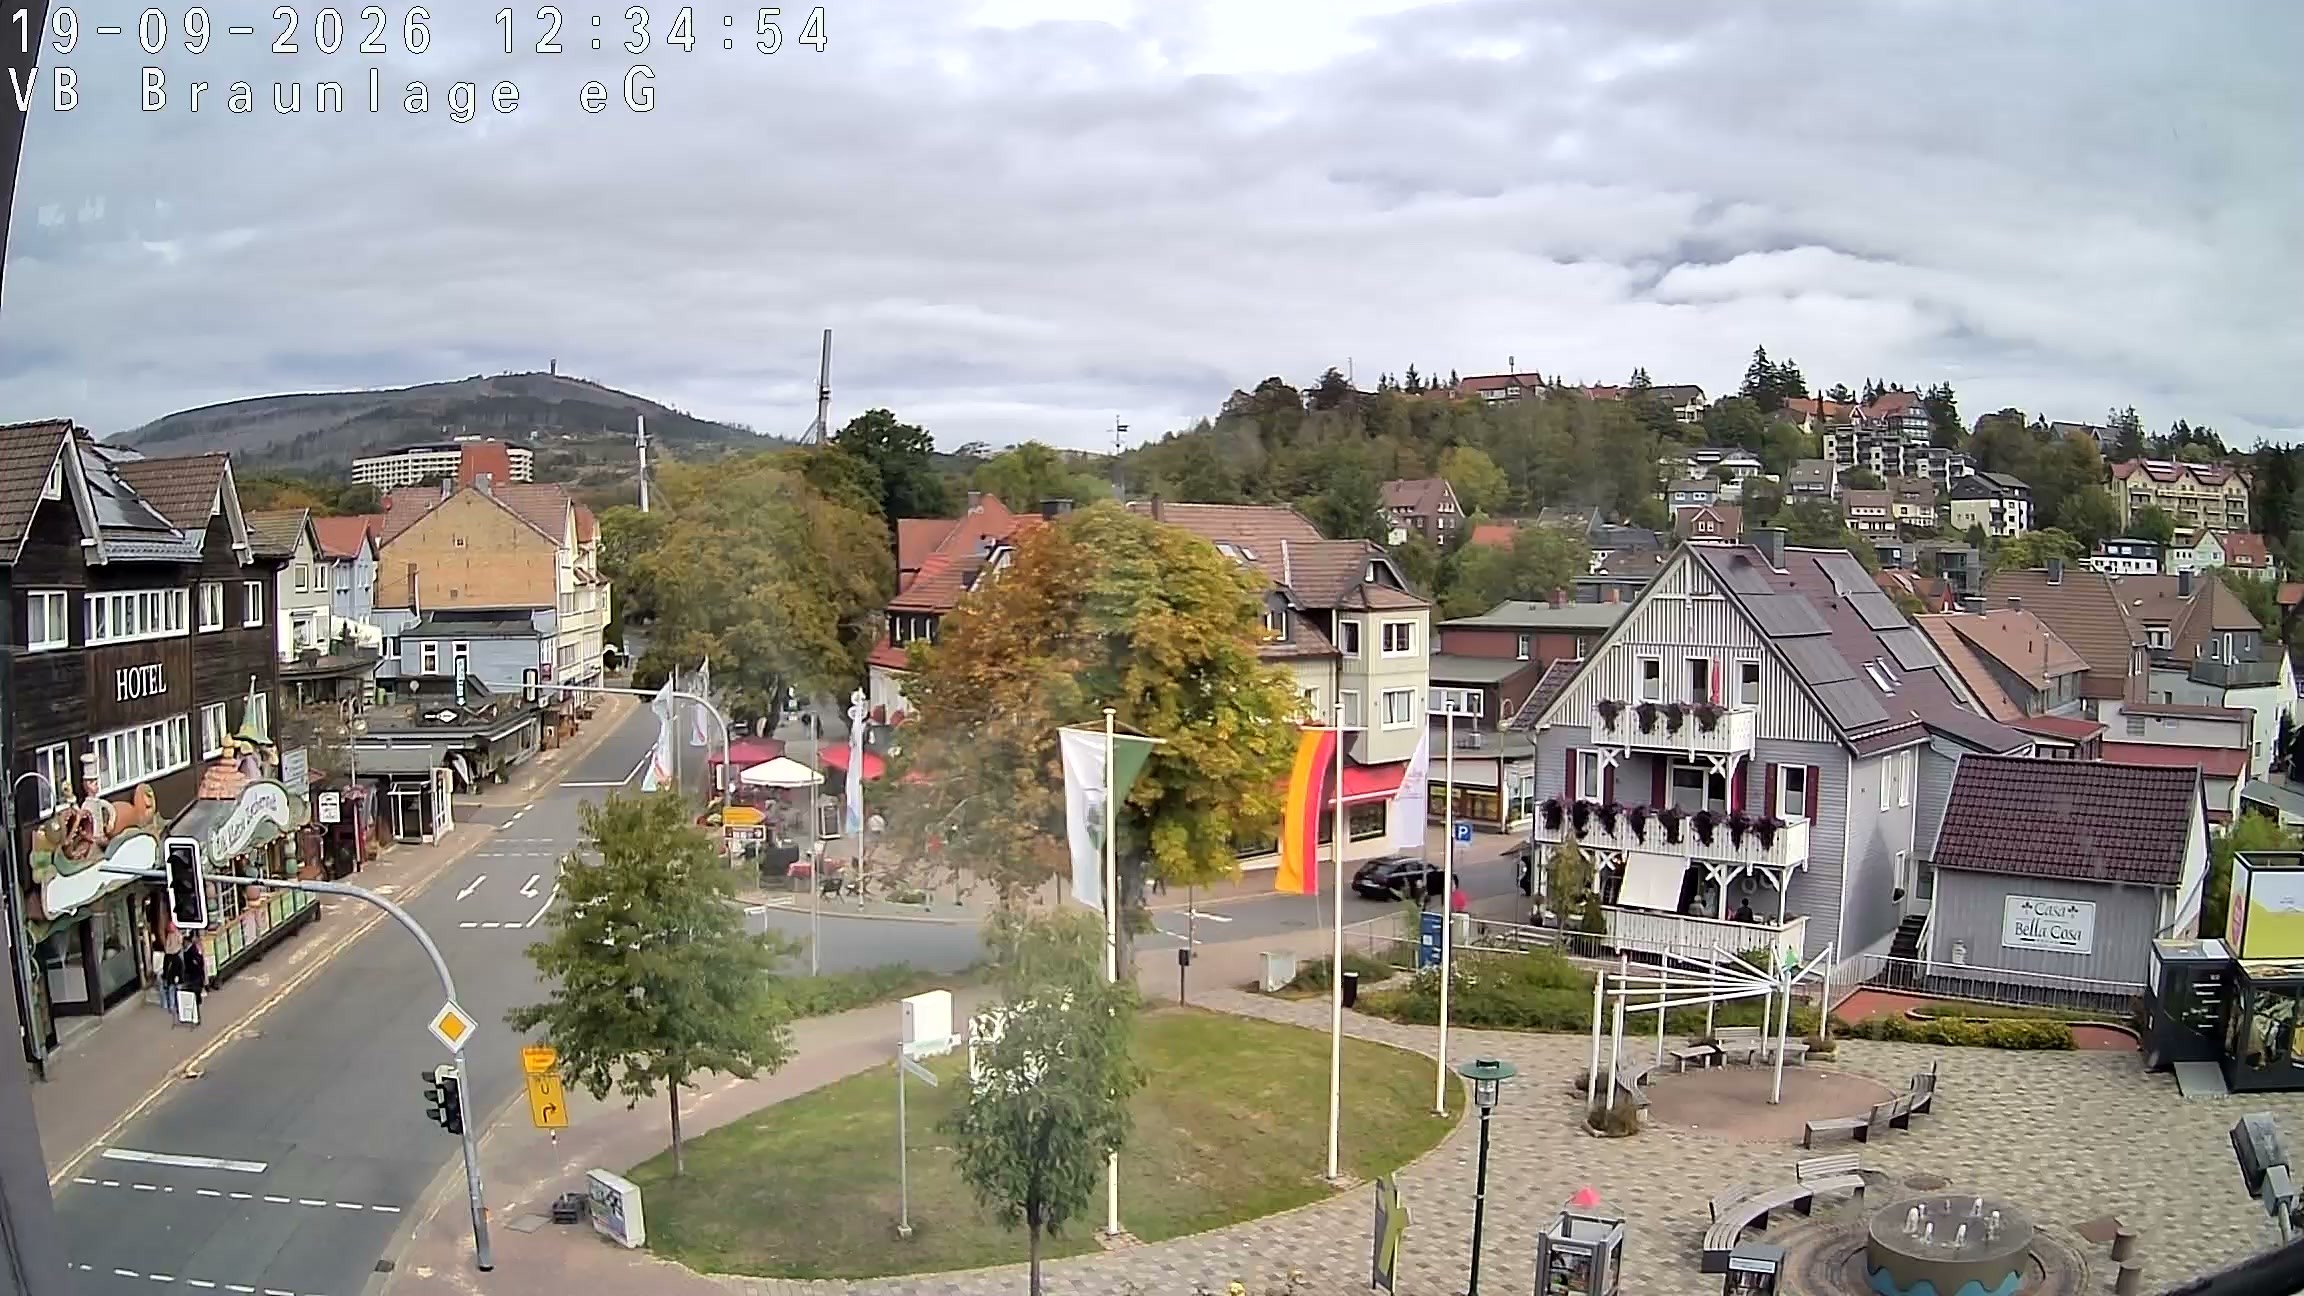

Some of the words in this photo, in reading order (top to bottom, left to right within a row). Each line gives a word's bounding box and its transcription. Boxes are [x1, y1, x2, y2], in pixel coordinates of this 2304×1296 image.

[115, 663, 168, 702] HOTEL
[1457, 825, 1469, 839] P
[2015, 918, 2048, 938] Bella
